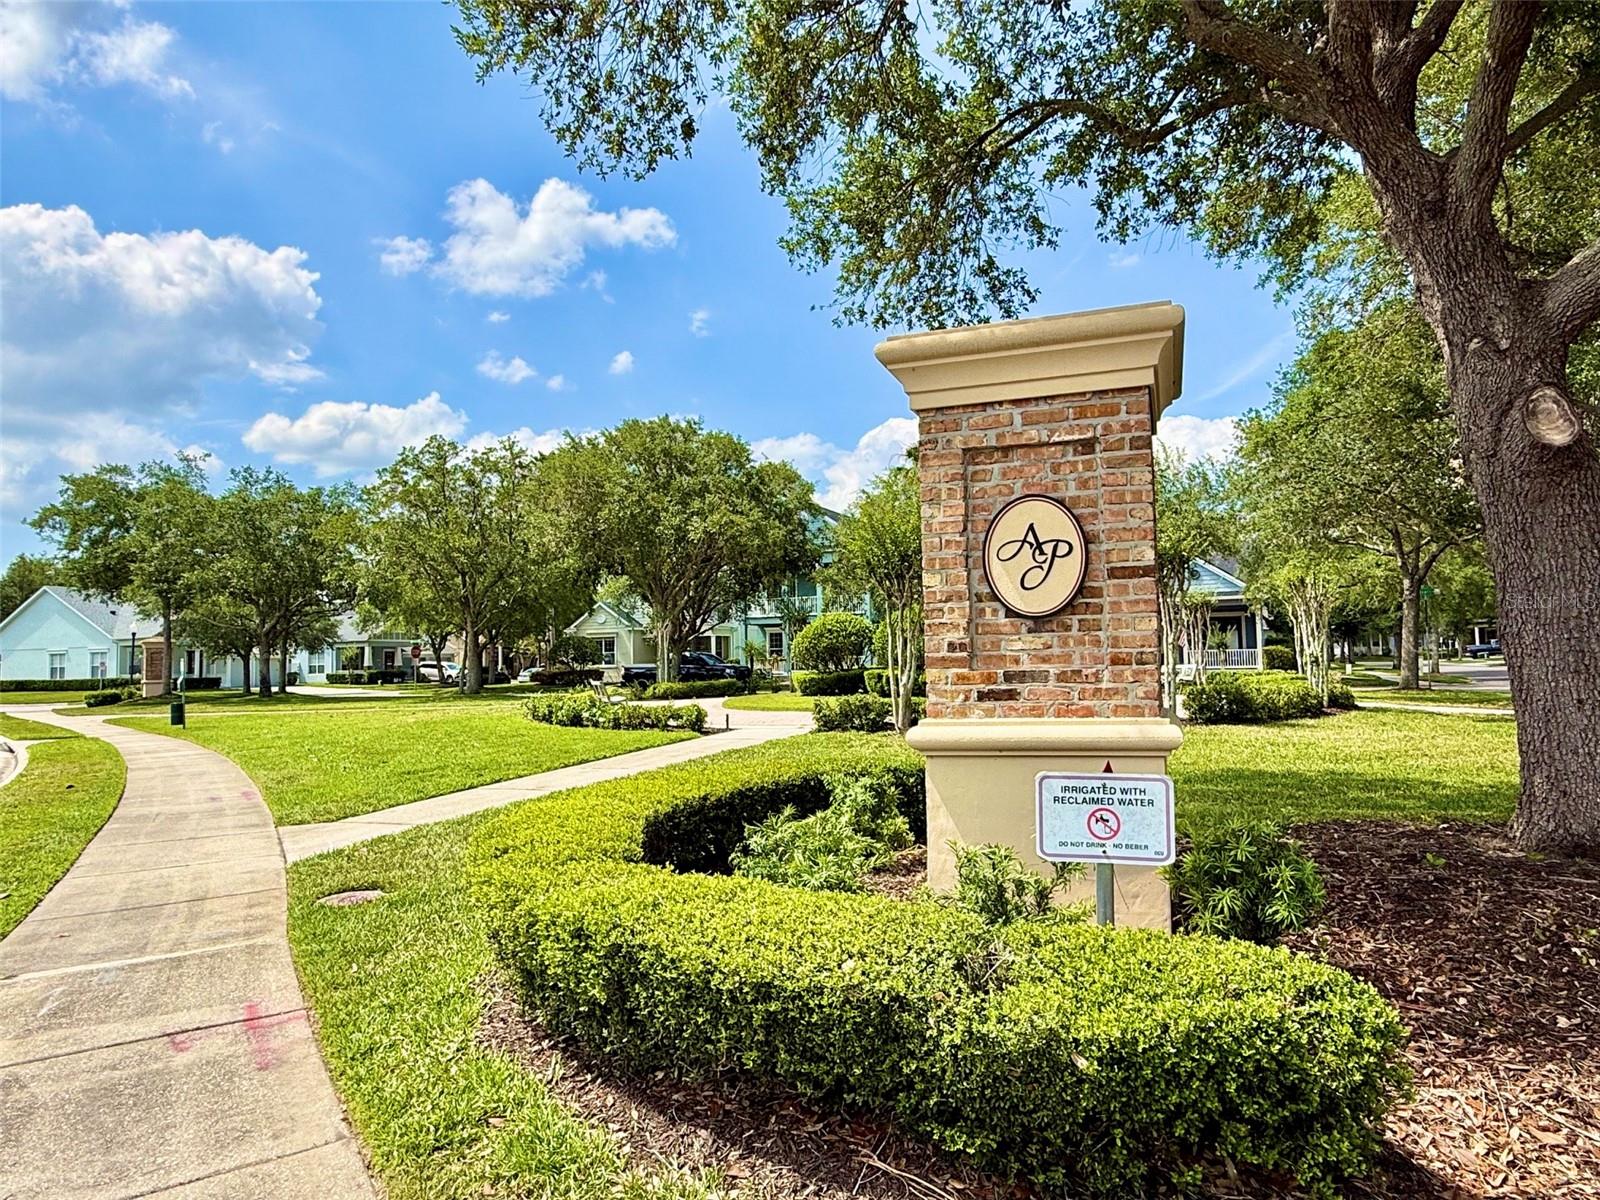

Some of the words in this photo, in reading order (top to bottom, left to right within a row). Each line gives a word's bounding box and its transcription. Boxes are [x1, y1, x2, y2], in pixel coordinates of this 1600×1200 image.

[1060, 785, 1117, 795] IRRIGATED
[1119, 787, 1147, 796] WITH
[1053, 796, 1115, 806] RECLAIMED
[1117, 798, 1155, 807] WATER
[1086, 841, 1108, 849] DRINK
